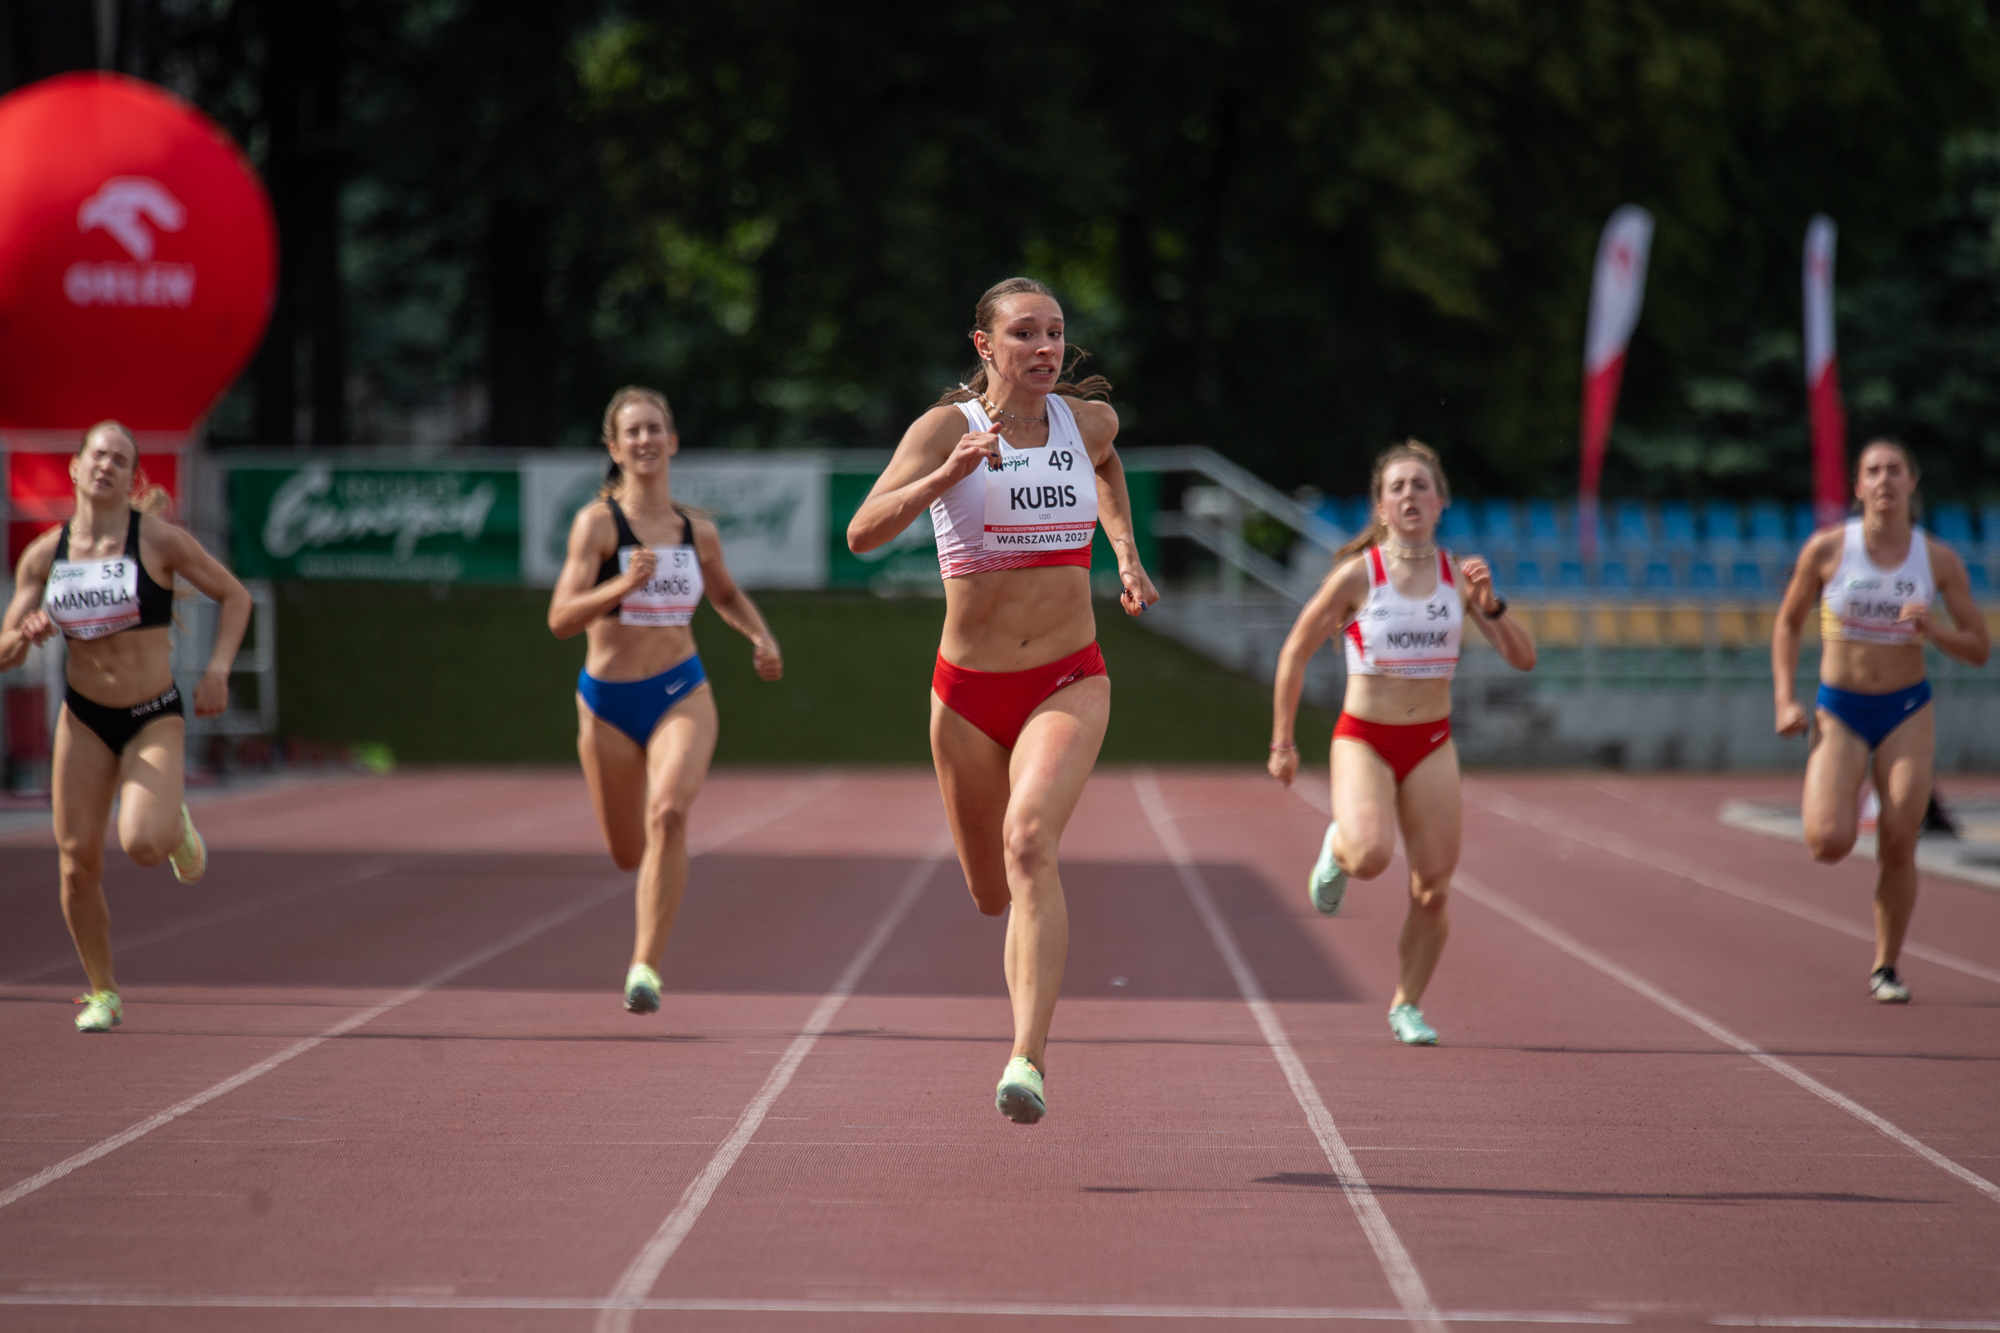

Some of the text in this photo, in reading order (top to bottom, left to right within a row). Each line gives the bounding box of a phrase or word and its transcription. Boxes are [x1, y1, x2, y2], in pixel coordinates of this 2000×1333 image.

[65, 262, 195, 307] ORLEN
[1048, 450, 1074, 471] 49
[1010, 485, 1077, 510] KUBIS
[997, 532, 1088, 544] WARSZAWA 2023
[673, 552, 690, 568] 57
[102, 563, 125, 579] 53
[1894, 581, 1915, 597] 59
[54, 588, 130, 611] MANDELA
[1427, 604, 1449, 621] 54
[1386, 631, 1448, 649] NOWAK
[131, 700, 160, 717] NIKE
